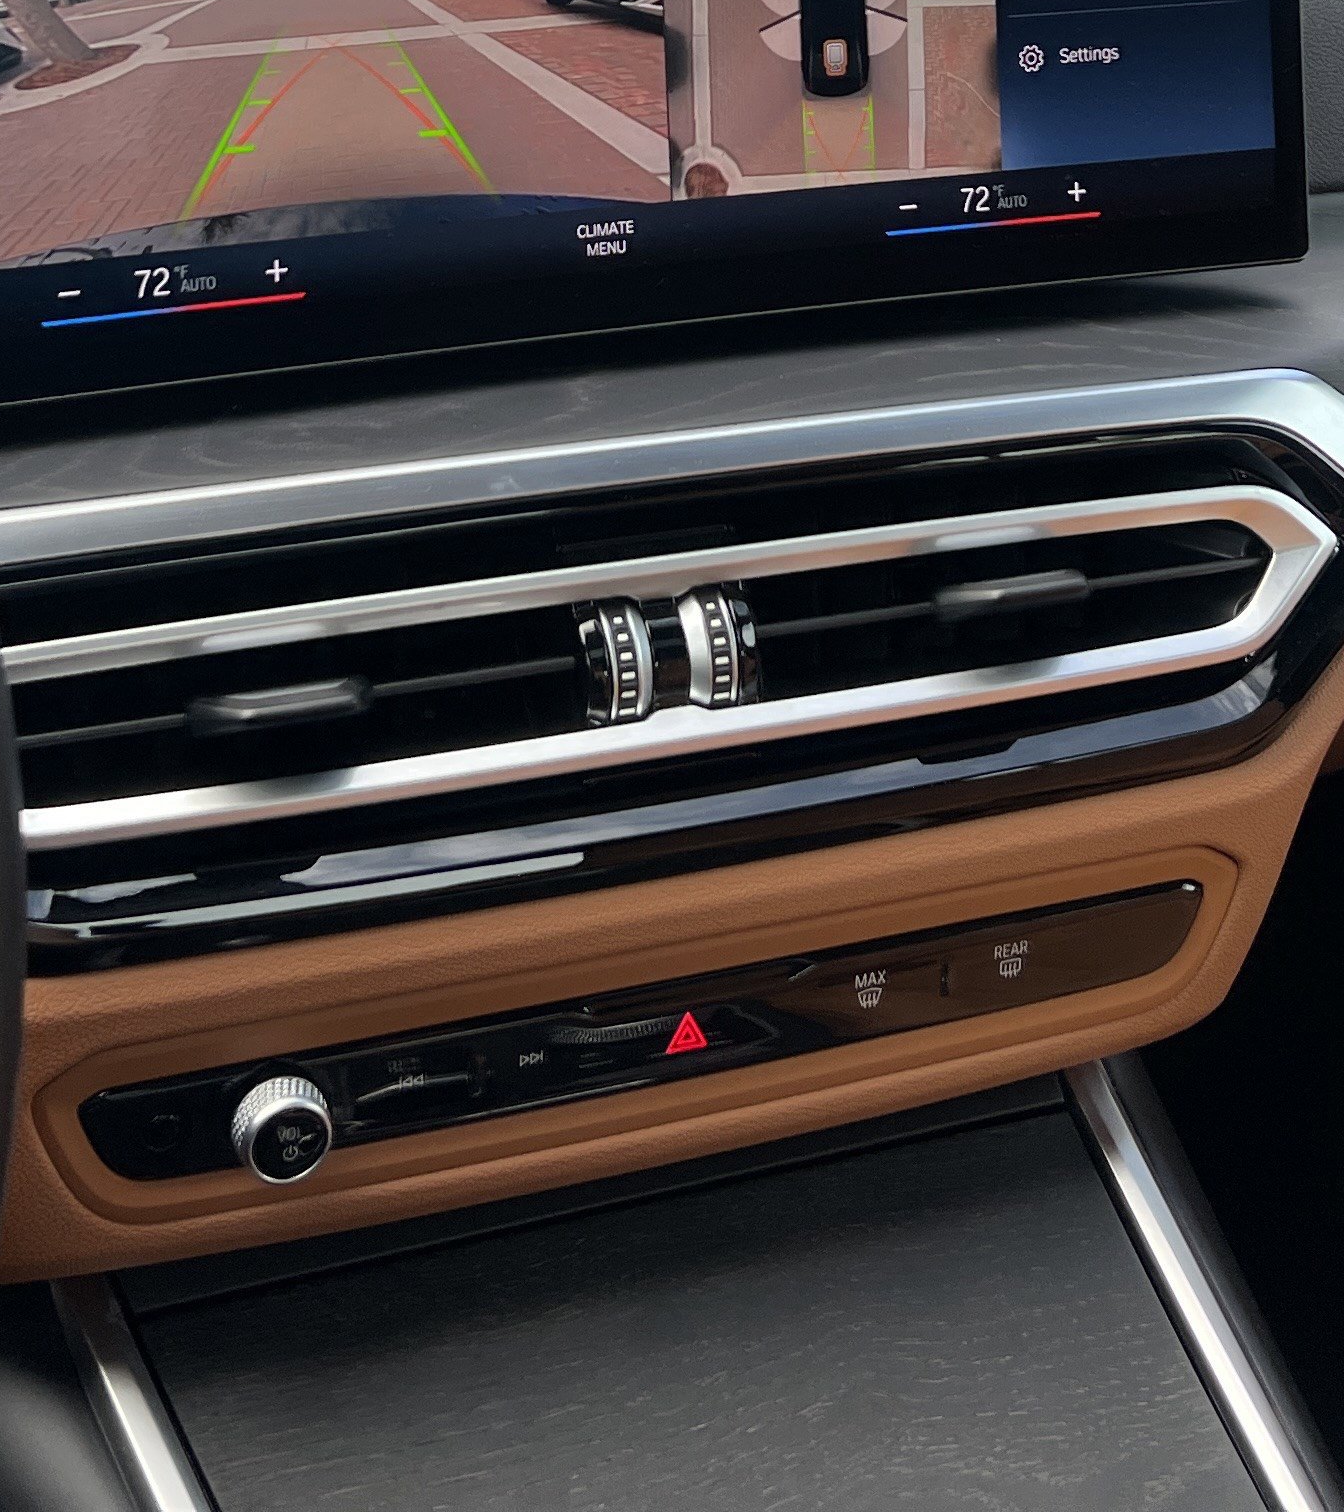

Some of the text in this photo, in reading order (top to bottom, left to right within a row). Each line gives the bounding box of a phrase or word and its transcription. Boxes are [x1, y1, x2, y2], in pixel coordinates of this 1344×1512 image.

[1059, 45, 1120, 65] Settings
[959, 184, 991, 214] 72
[996, 195, 1028, 210] AUTO
[576, 220, 635, 239] CLIMATE
[586, 239, 627, 257] MENU
[133, 267, 172, 300] 72
[180, 275, 217, 293] AUTO
[994, 940, 1028, 960] REAR
[855, 969, 887, 989] MAX
[276, 1125, 302, 1144] VOL
